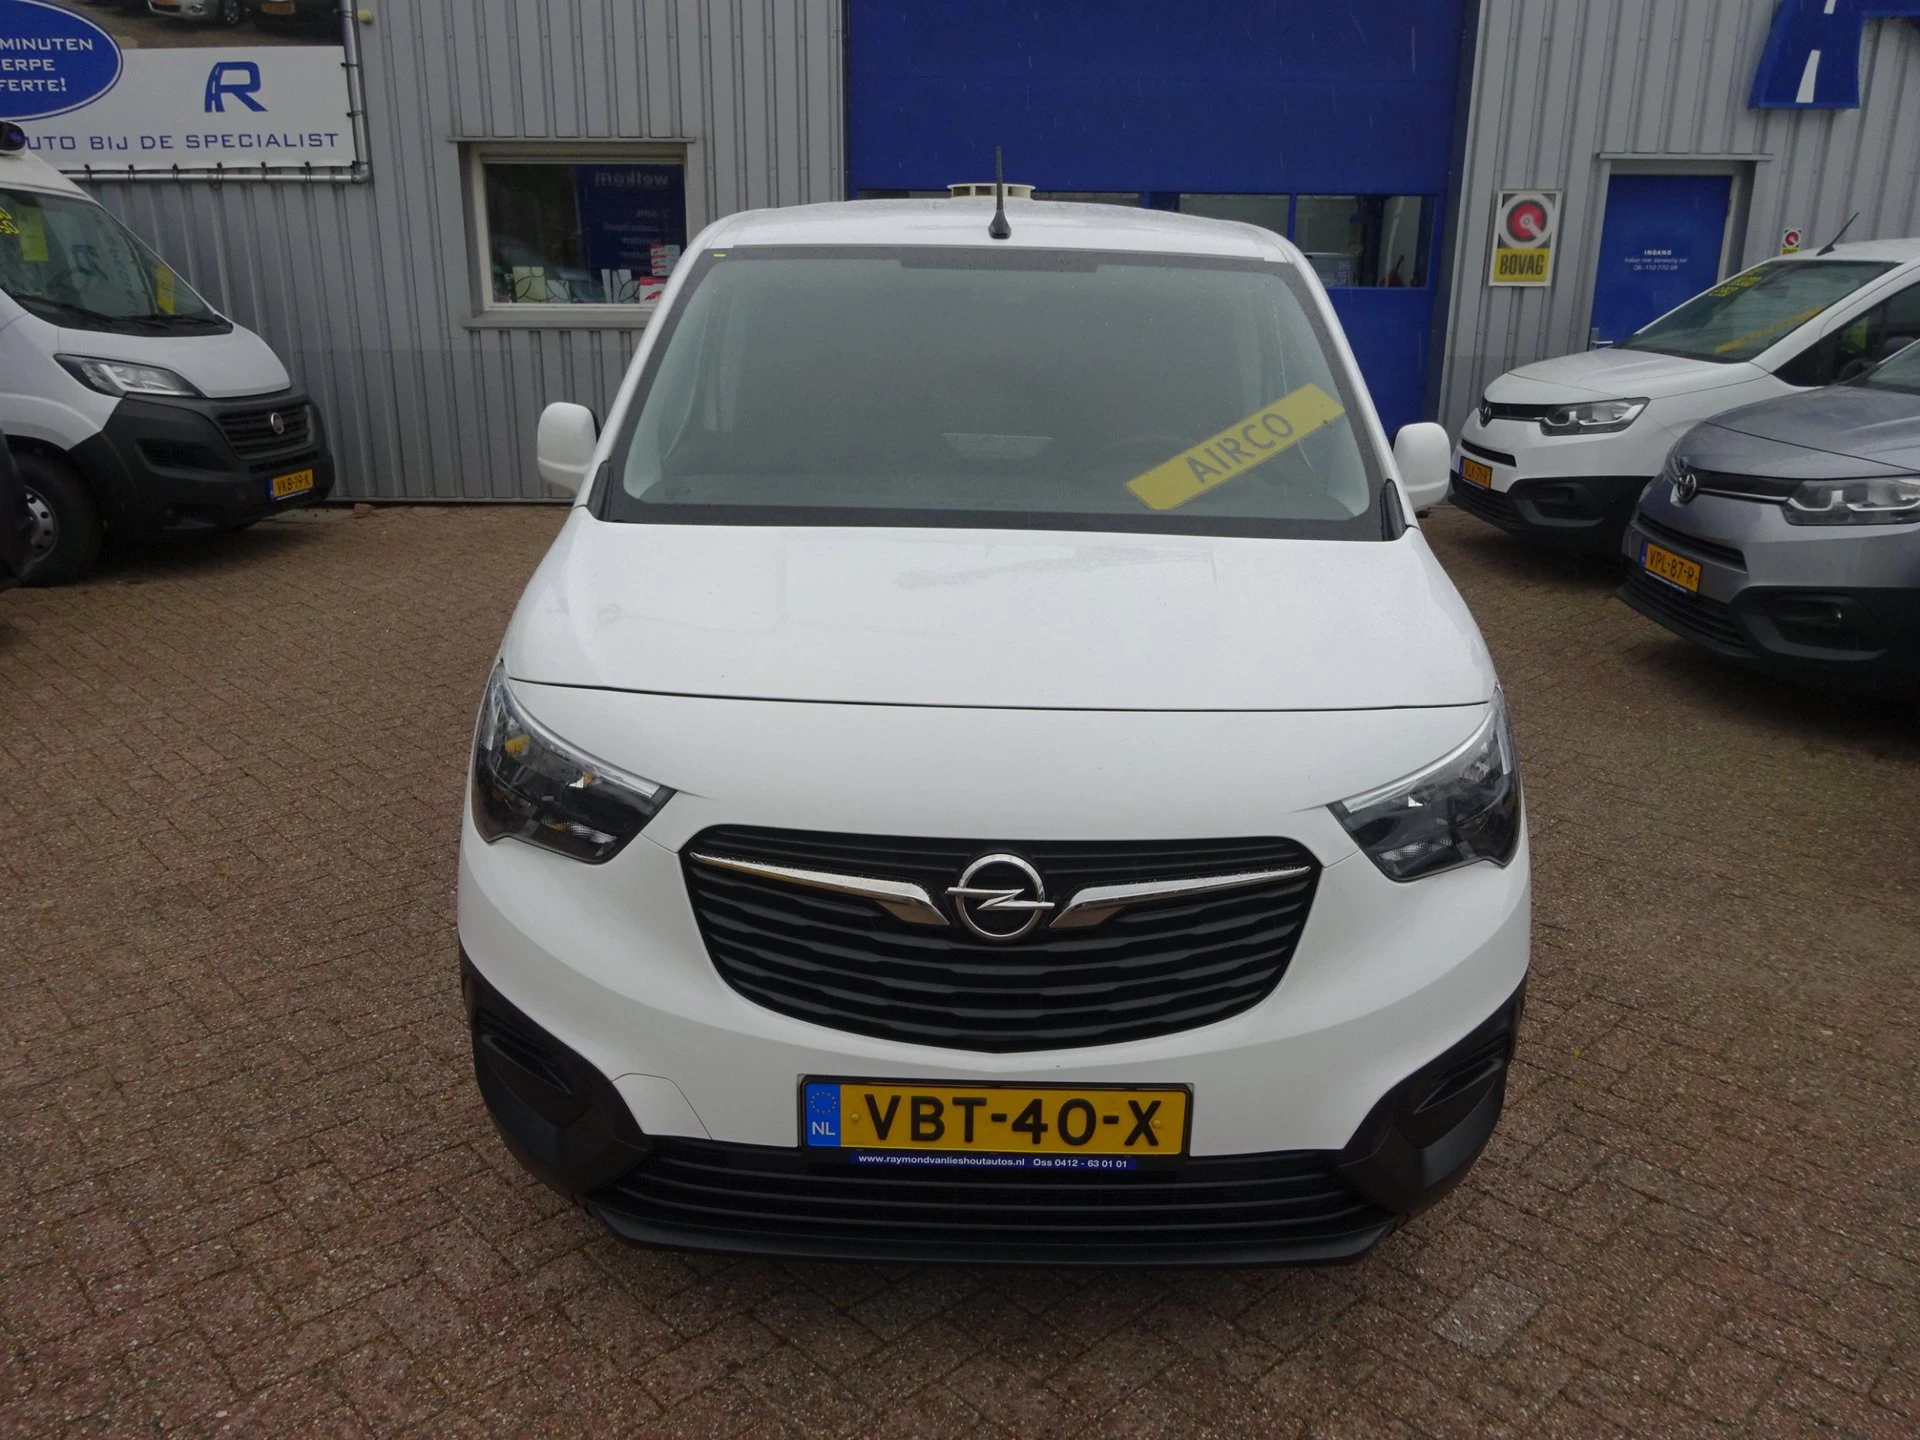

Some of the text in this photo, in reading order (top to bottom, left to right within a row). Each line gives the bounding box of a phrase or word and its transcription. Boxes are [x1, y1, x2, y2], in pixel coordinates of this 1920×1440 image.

[0, 38, 94, 51] MINUTEN
[1, 58, 55, 72] ERPE
[25, 132, 340, 151] UTO BIJ DE SPECIALIST
[1499, 254, 1545, 275] BOVAG
[1184, 412, 1294, 484] AIRCO
[1650, 549, 1695, 586] VPL-87-R
[811, 1093, 1163, 1147] NL VBT-40-X
[858, 1154, 1025, 1167] www.raymondvanlieshoutautos.nl
[1033, 1158, 1053, 1167] Oss
[1054, 1159, 1079, 1167] 0412
[1087, 1159, 1100, 1168] 63
[1101, 1160, 1113, 1168] 01
[1115, 1160, 1128, 1168] 01
